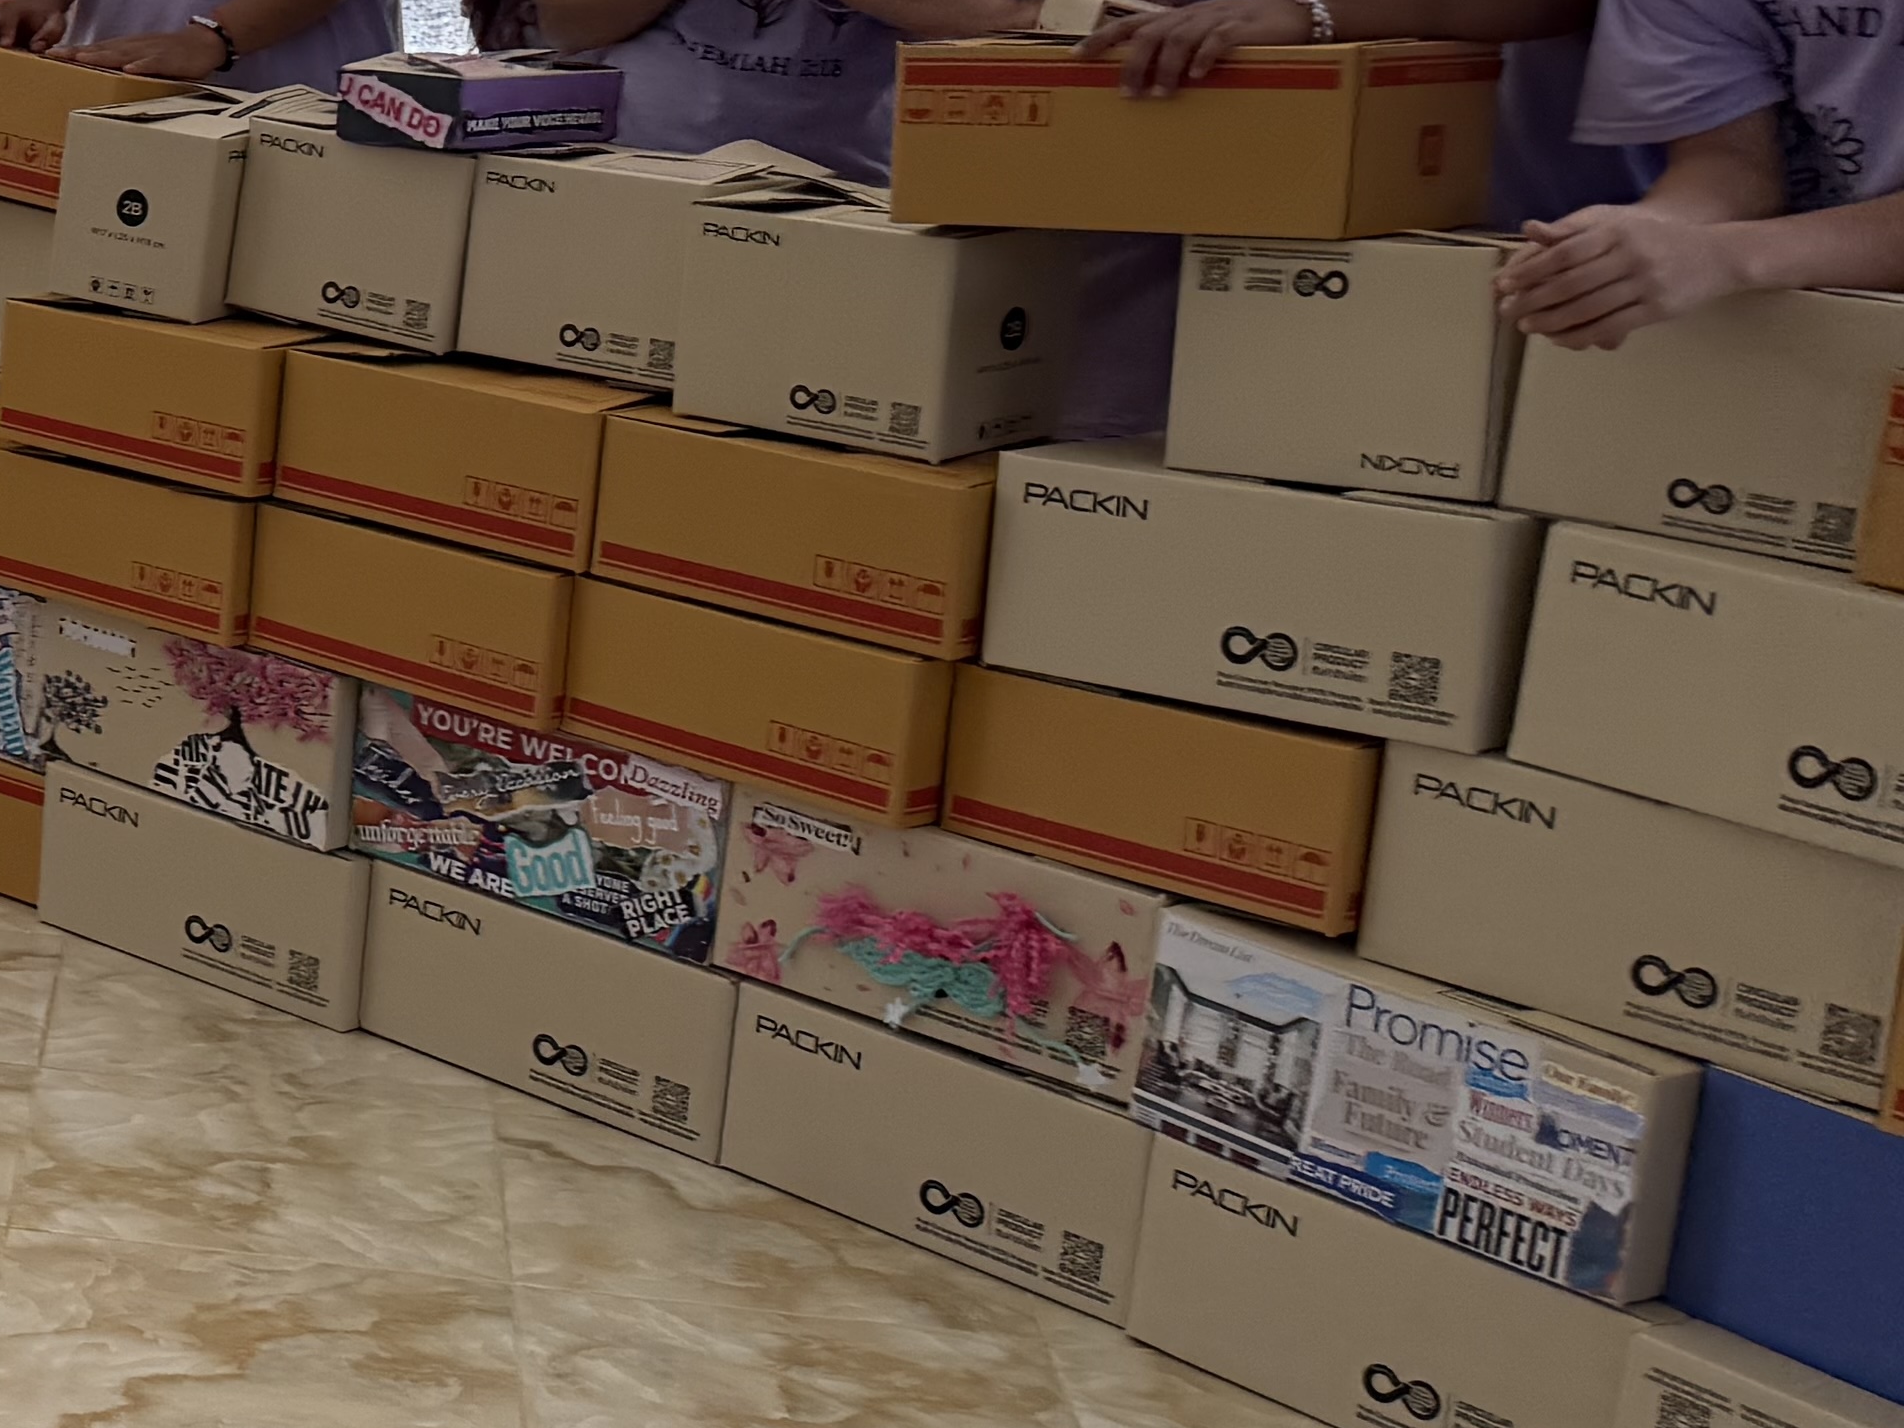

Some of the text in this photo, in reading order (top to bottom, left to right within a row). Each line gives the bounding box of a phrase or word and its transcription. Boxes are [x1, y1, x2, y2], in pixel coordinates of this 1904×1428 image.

[357, 82, 443, 139] CAN DO
[258, 132, 325, 160] PACKIN
[484, 170, 557, 195] PACKIN
[121, 200, 144, 216] 2B
[701, 221, 782, 247] PACKIN
[1359, 452, 1461, 480] PACKIN
[1021, 481, 1150, 520] PACKIN
[1568, 559, 1718, 618] PACKIN
[416, 703, 515, 752] YOU'RE
[58, 786, 140, 829] PACKIN
[629, 764, 720, 816] Dazzling
[1412, 772, 1558, 831] PACKIN
[761, 808, 849, 849] So Sweet!
[427, 852, 517, 899] WE ARE
[509, 830, 591, 895] Good
[387, 888, 482, 936] PACKIN
[620, 889, 684, 920] RIGHT
[625, 904, 693, 939] PLACE
[754, 1013, 863, 1071] PACKIN
[1344, 982, 1530, 1083] Promise
[1334, 1069, 1414, 1121] Family
[1290, 1156, 1398, 1209] REAT PRIDE
[1457, 1118, 1554, 1172] Student
[1563, 1156, 1626, 1200] Days
[1168, 1169, 1301, 1239] PACKIN
[1447, 1166, 1525, 1208] ENDLESS
[1529, 1197, 1579, 1229] WAYS
[1438, 1187, 1570, 1280] PERFECT
